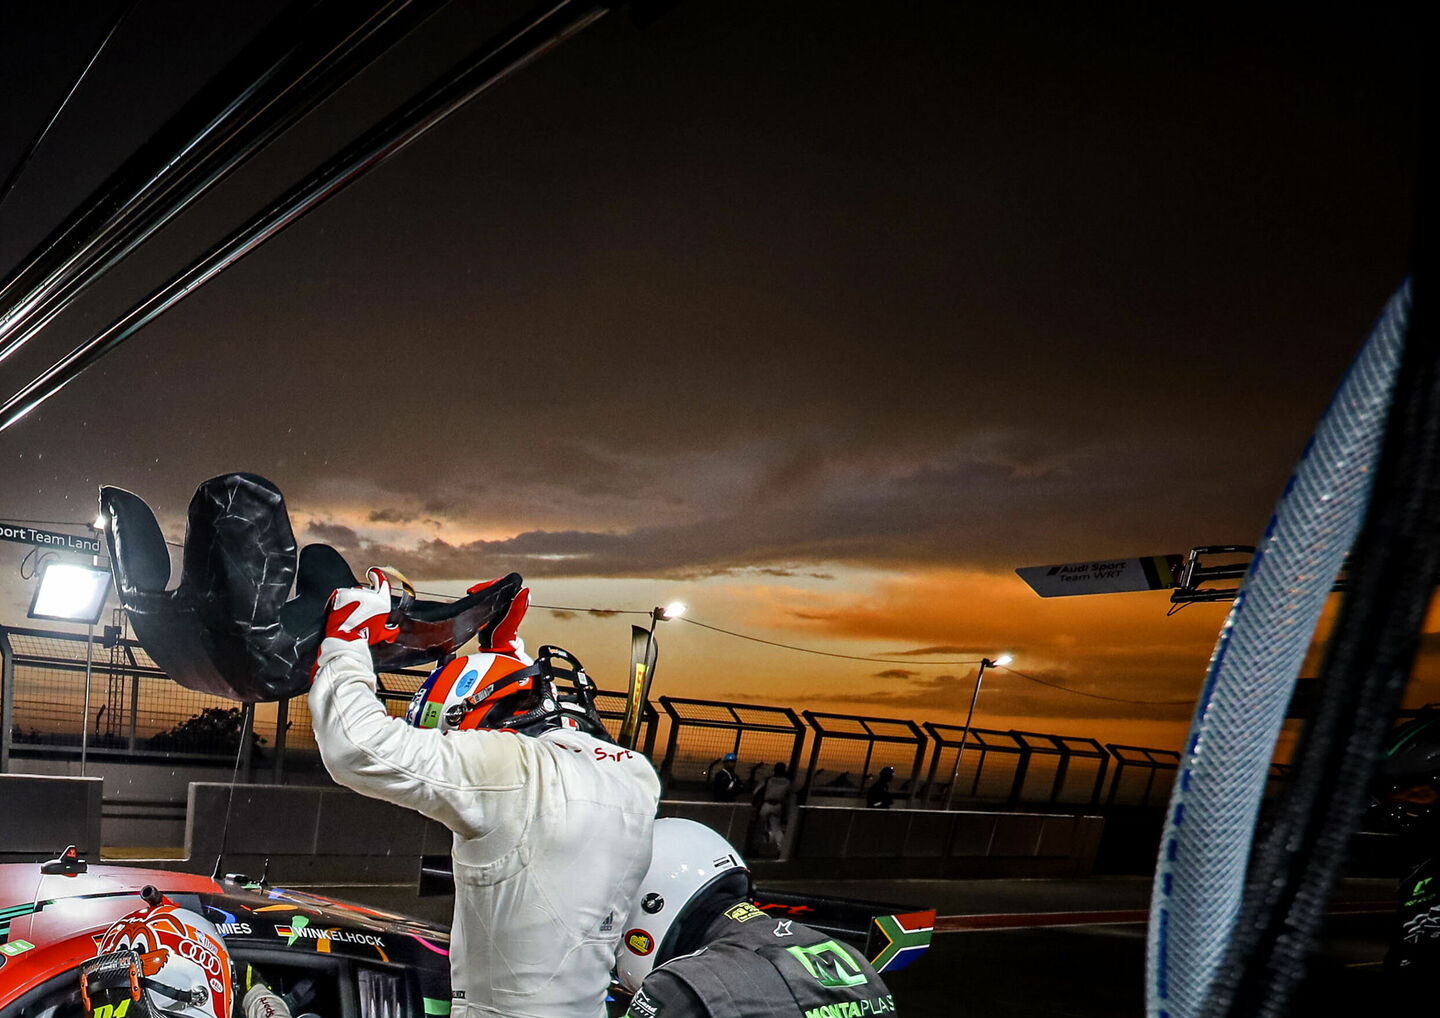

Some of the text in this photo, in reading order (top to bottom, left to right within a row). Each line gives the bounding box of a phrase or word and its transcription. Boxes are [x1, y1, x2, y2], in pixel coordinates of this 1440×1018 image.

[27, 529, 65, 546] Team
[68, 535, 100, 551] Land
[1060, 561, 1127, 574] Audi Sport
[1060, 570, 1123, 582] Team WRT
[294, 926, 386, 948] WINKELHOCK
